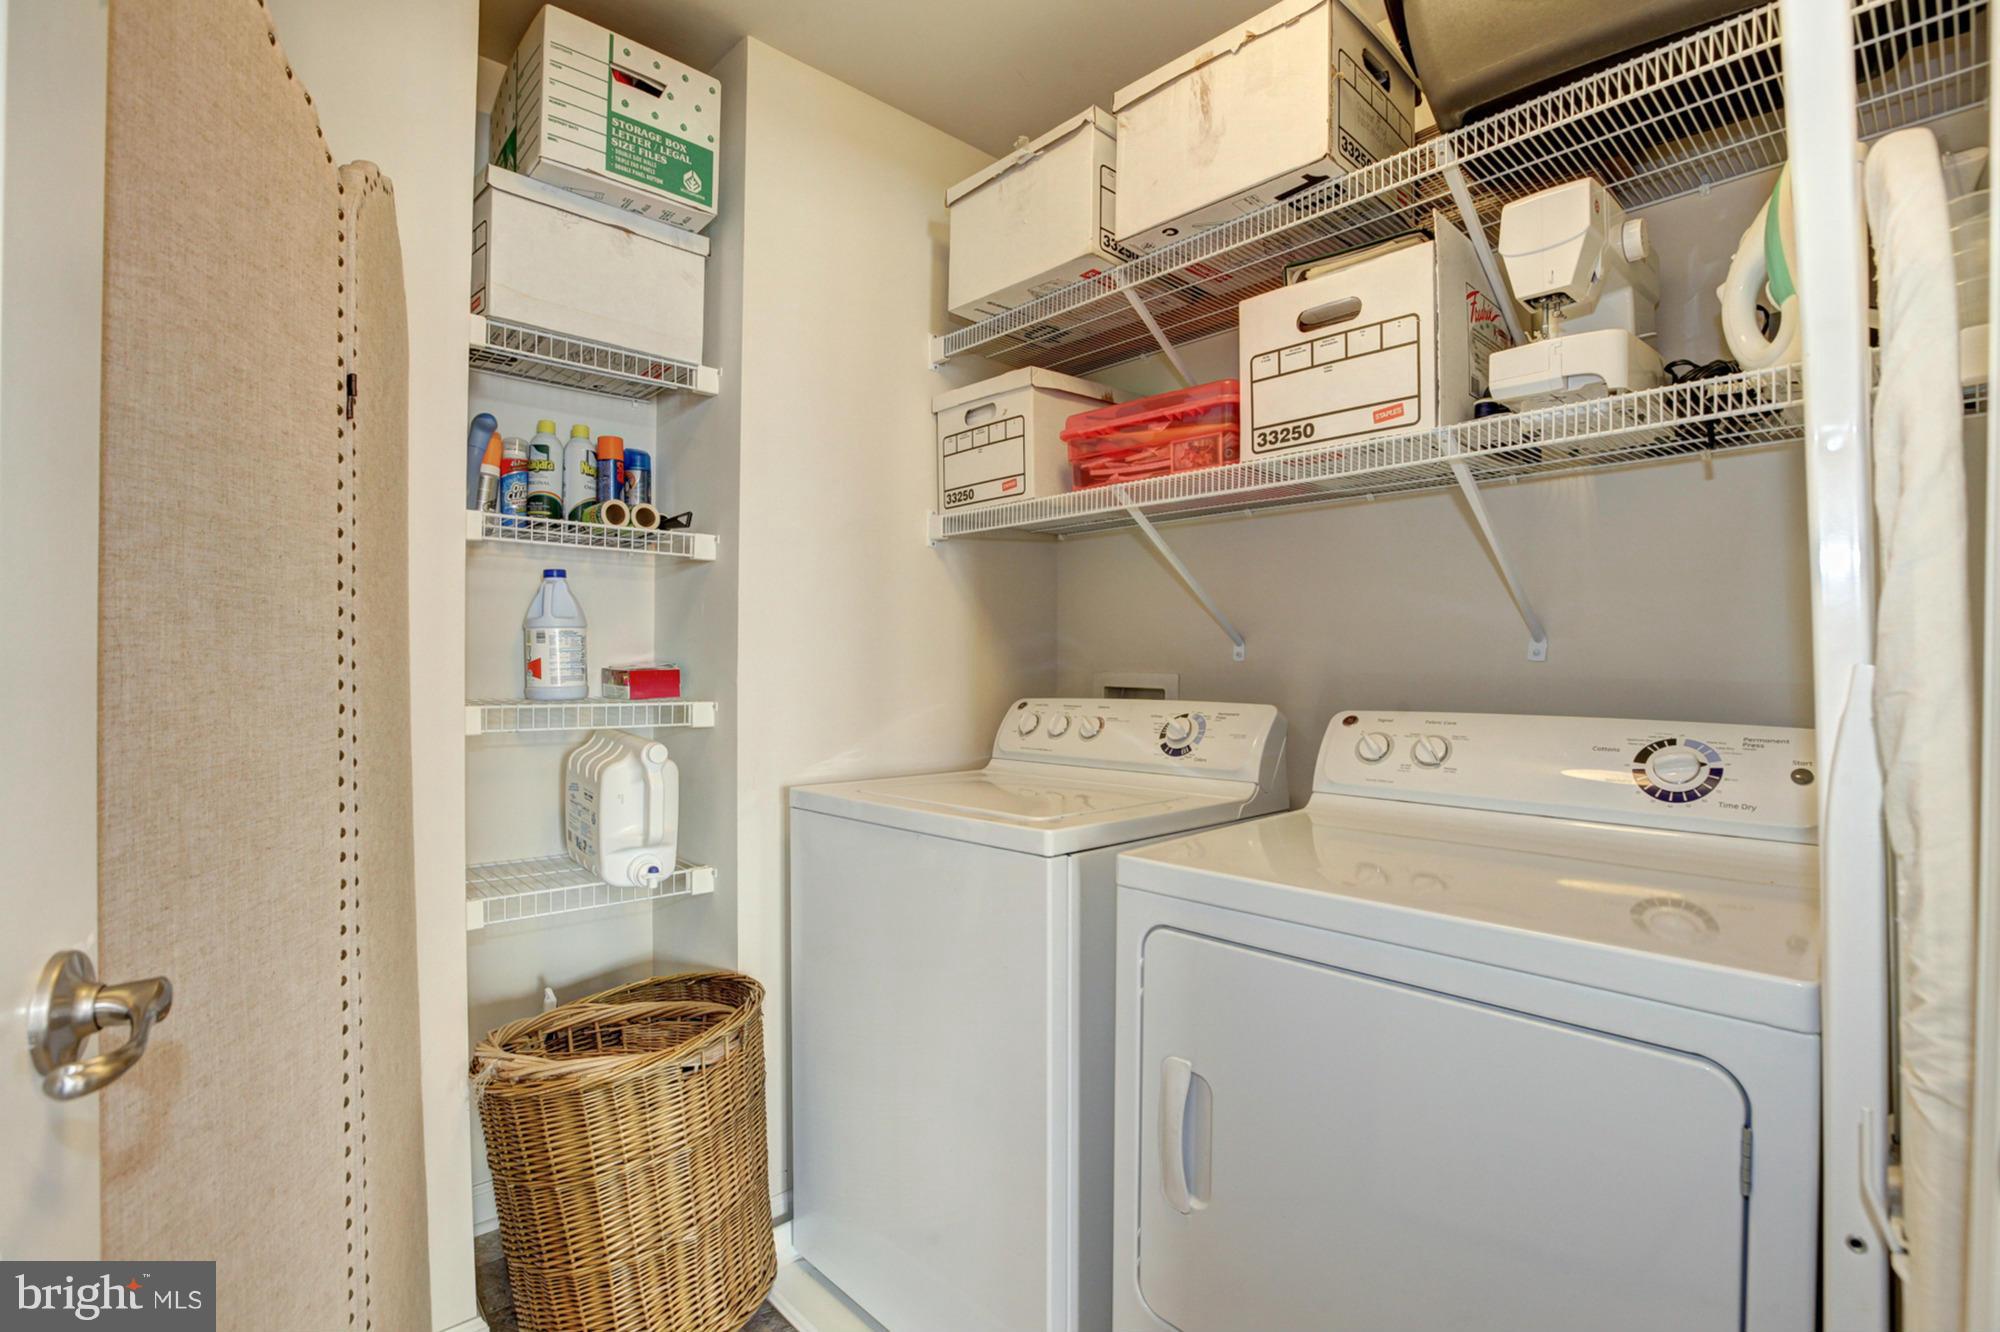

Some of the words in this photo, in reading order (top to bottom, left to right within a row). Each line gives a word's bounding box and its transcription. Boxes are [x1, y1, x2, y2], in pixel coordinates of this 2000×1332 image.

[611, 117, 662, 143] STORAGE
[665, 138, 688, 153] BOX
[611, 128, 652, 149] LETTER
[660, 146, 692, 165] LEGAL
[611, 137, 636, 153] SIZE
[638, 147, 668, 165] FILES
[1257, 422, 1315, 448] 33250
[946, 488, 975, 505] 33250
[1592, 745, 1621, 753] Cottons
[1742, 737, 1790, 745] Permanent
[1718, 801, 1740, 810] Time
[1742, 803, 1757, 813] Dry
